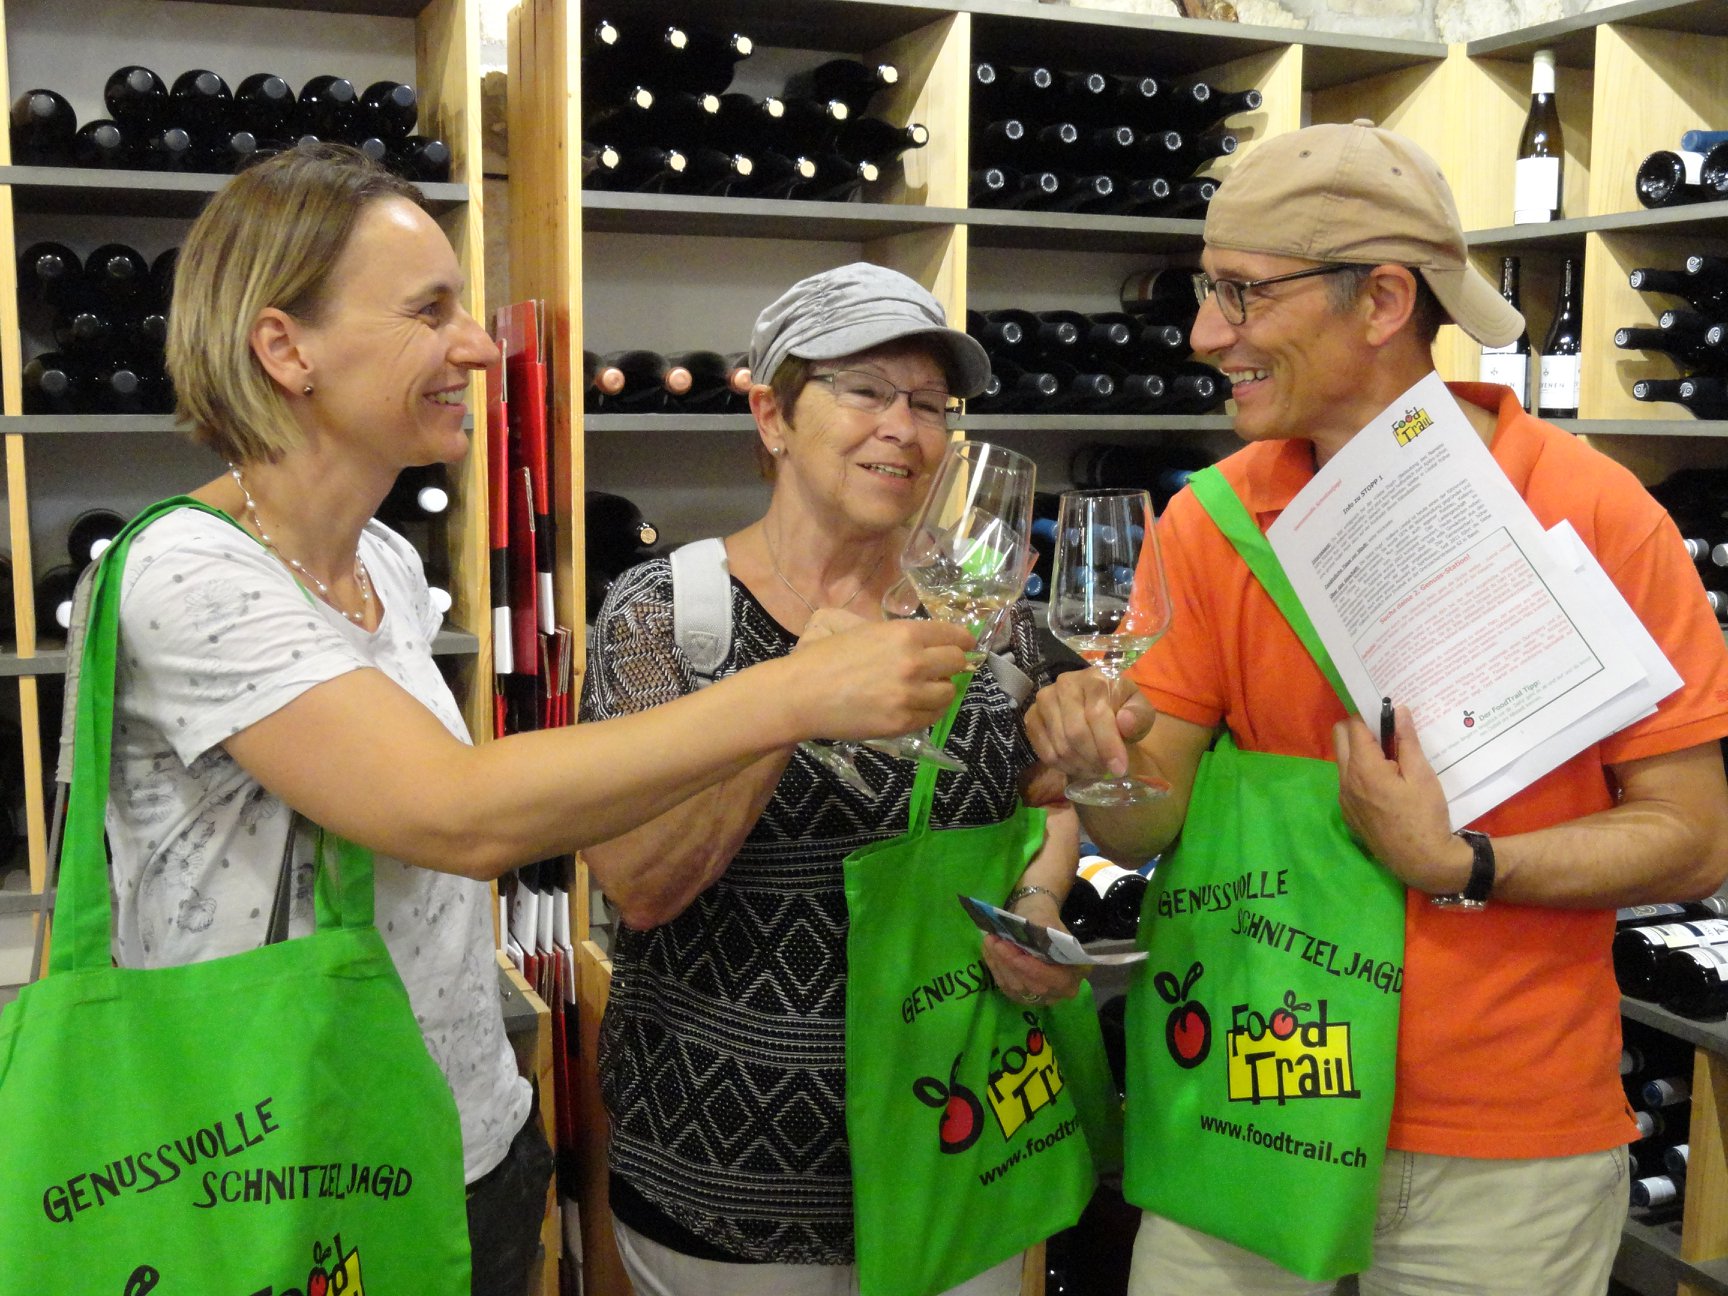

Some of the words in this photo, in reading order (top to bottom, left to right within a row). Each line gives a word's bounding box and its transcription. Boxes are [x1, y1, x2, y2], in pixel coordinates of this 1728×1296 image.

[1392, 407, 1421, 436] Food
[1402, 420, 1434, 443] Trail
[1342, 502, 1354, 515] Info
[1360, 480, 1379, 498] STOPP
[1380, 608, 1397, 625] Suche
[1479, 711, 1491, 722] Der
[1491, 690, 1523, 714] FoodTrail
[1158, 869, 1289, 919] GENUSSVOLLE
[1232, 999, 1328, 1057] Food
[1245, 1051, 1361, 1106] Trail
[43, 1096, 280, 1224] GENUSSVOLLE
[1200, 1115, 1367, 1168] www.foodtrail.ch
[192, 1163, 413, 1209] SCHNITZELJAGD
